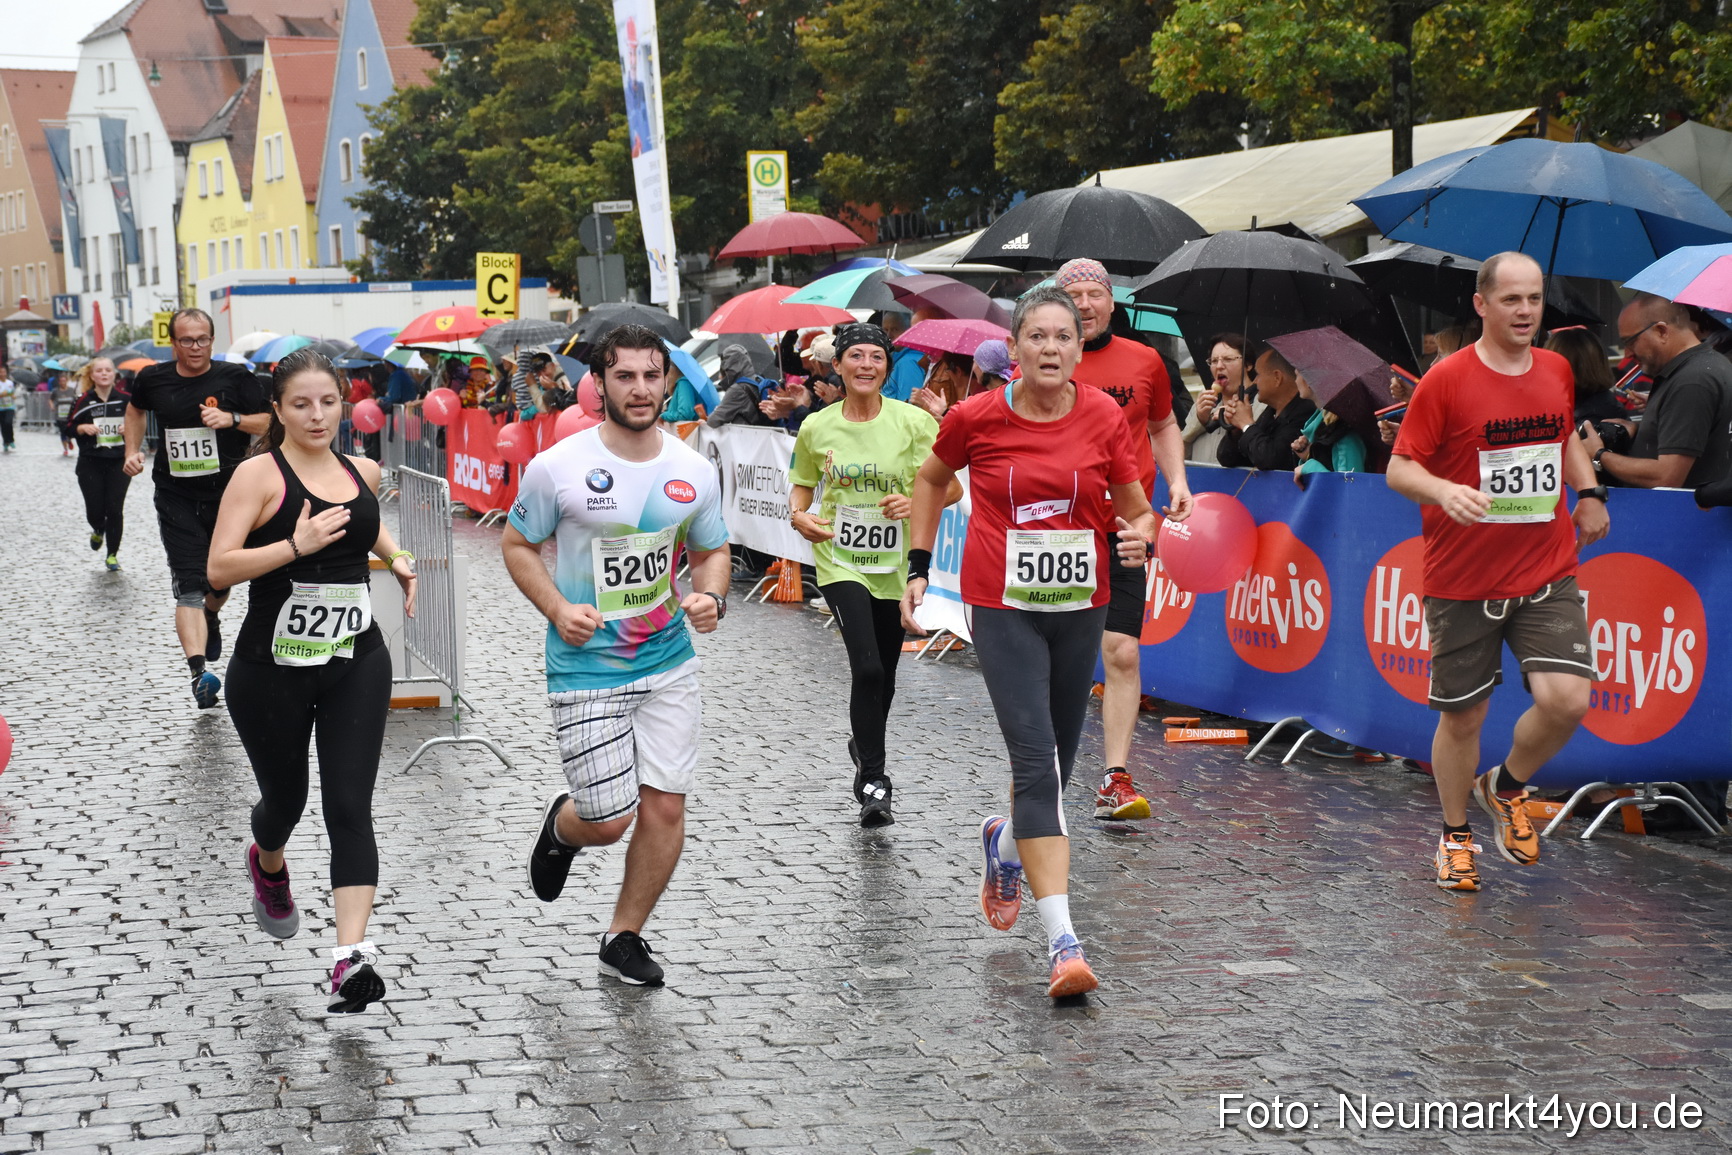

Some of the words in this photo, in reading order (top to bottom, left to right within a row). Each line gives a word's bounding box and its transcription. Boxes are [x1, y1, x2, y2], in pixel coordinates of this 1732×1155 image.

[761, 163, 775, 181] H
[1001, 241, 1032, 250] adidas
[481, 255, 516, 269] Block
[487, 272, 509, 306] C
[158, 322, 170, 340] D
[1490, 431, 1510, 442] RUN
[1511, 429, 1527, 440] FOR
[169, 439, 213, 459] 5115
[178, 462, 205, 471] Norbert
[854, 478, 898, 494] LAUF
[1489, 463, 1556, 494] 5313
[668, 484, 694, 498] Hervis
[586, 497, 617, 506] PARTL
[1031, 504, 1055, 517] DEHN
[1490, 500, 1533, 513] Andreas
[633, 529, 672, 548] BOCK
[839, 521, 897, 549] 5260
[1049, 533, 1088, 544] BOCK
[603, 545, 669, 588] 5205
[851, 553, 879, 566] Ingrid
[1016, 551, 1089, 584] 5085
[325, 587, 361, 599] BOCK
[623, 586, 658, 606] Ahmad
[1028, 591, 1073, 603] Martina
[1229, 564, 1325, 644] Hervis
[1373, 565, 1430, 651] Her
[287, 604, 363, 639] 5270
[1233, 627, 1278, 649] SPORTS
[1578, 589, 1696, 709] ervis
[1381, 652, 1432, 678] SPORTS
[1589, 688, 1632, 715] ORTS
[1186, 728, 1237, 738] BRANDING
